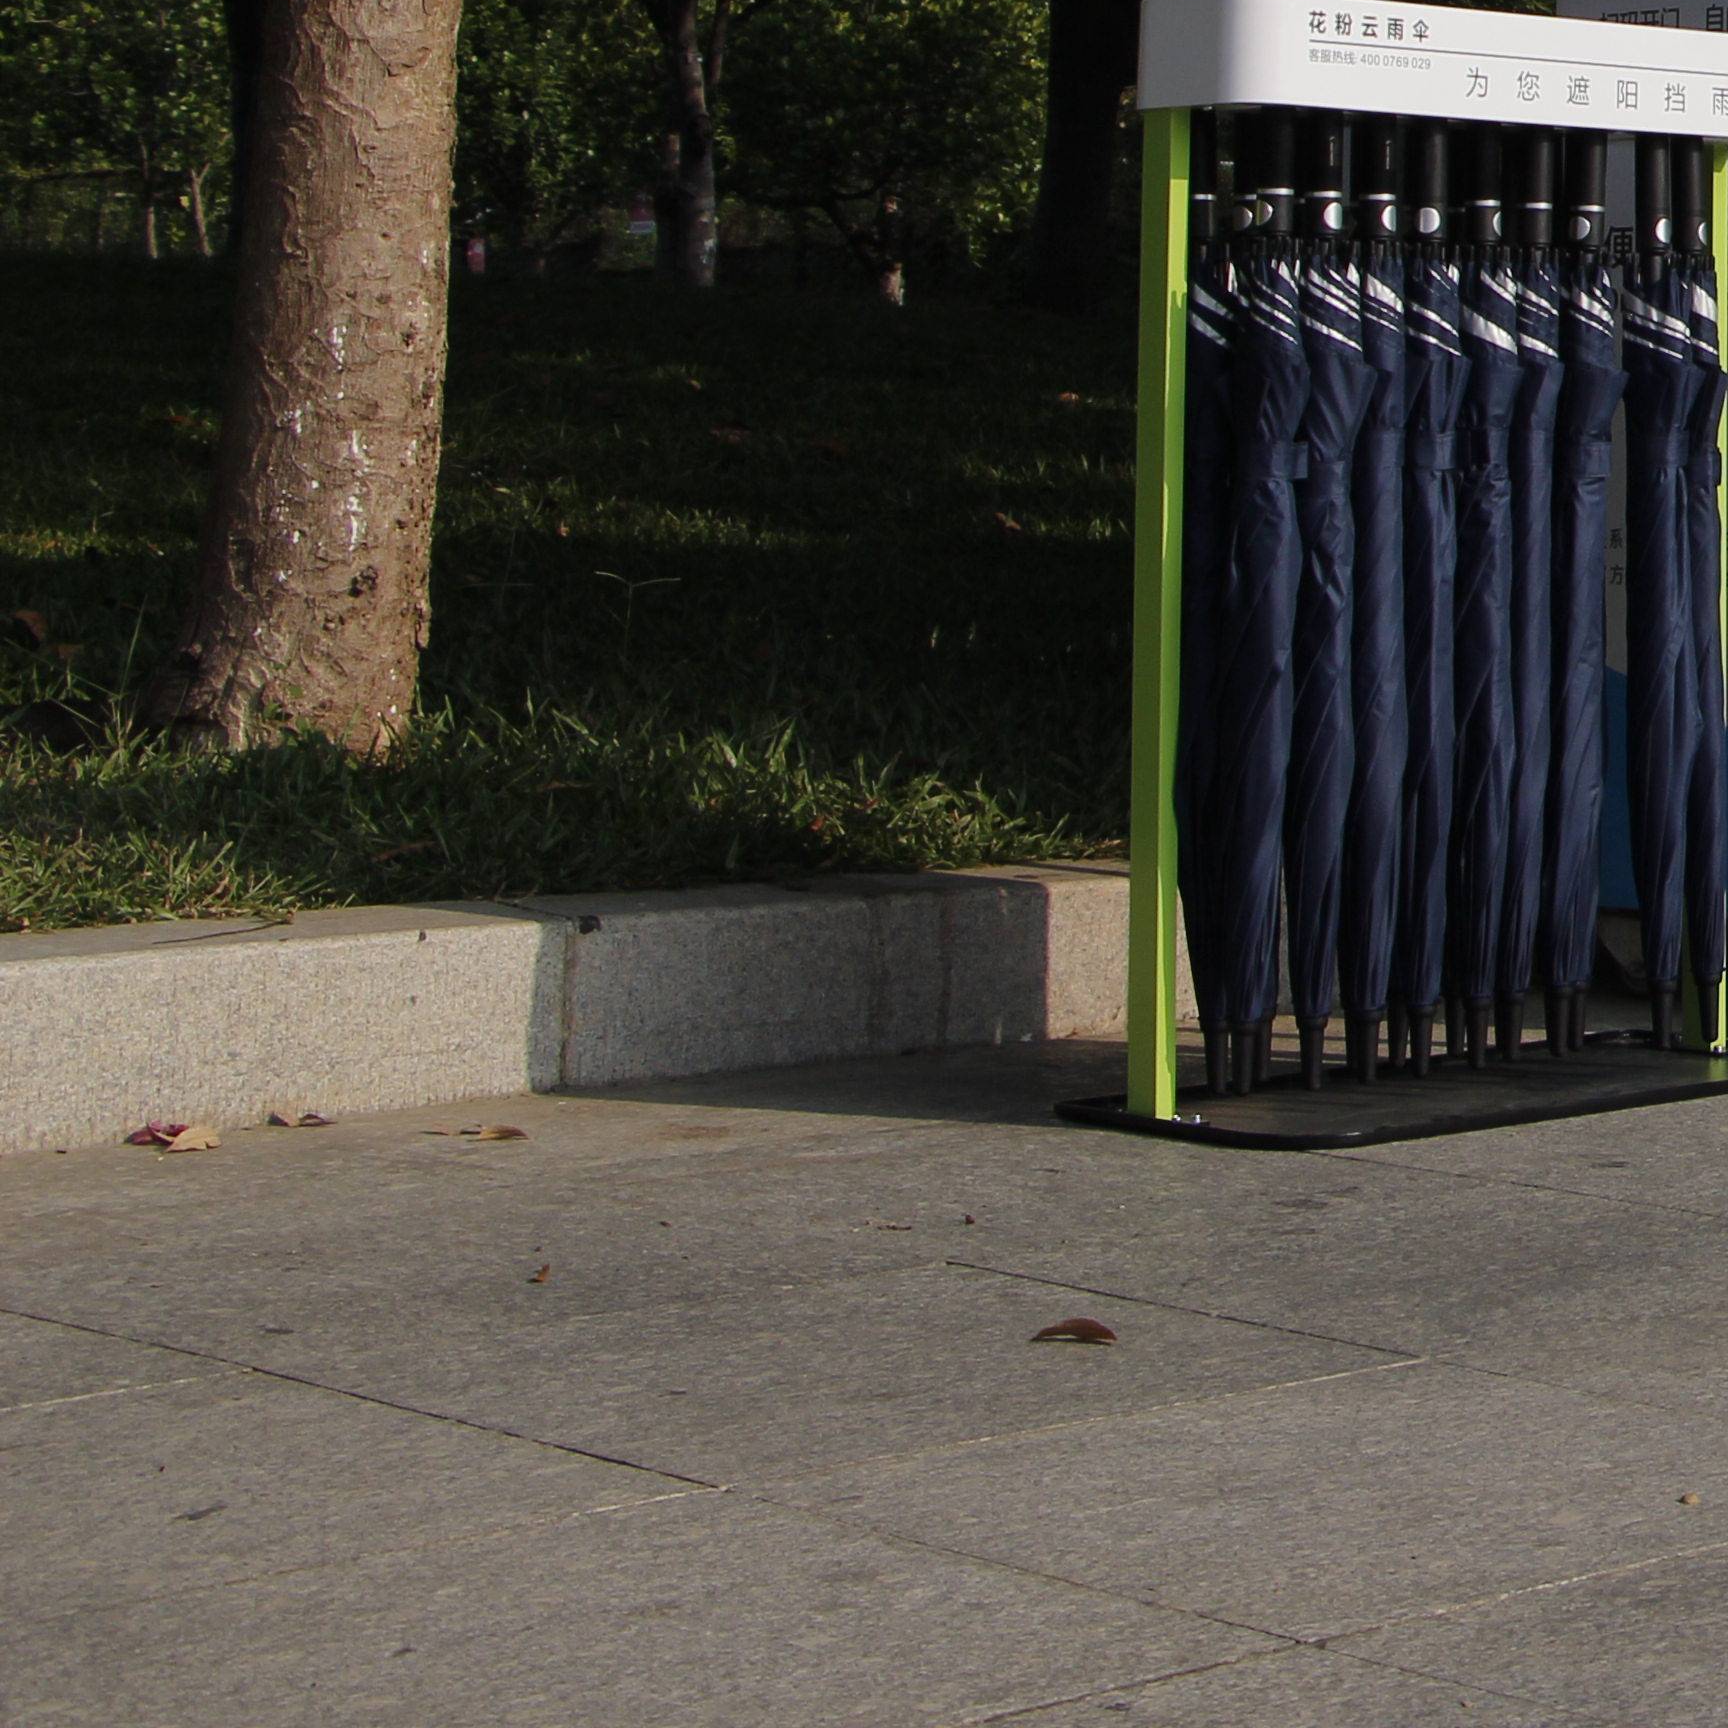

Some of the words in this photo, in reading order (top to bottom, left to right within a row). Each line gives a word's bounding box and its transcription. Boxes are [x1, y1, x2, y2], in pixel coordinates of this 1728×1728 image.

[1308, 9, 1431, 44] 花粉云雨伞
[1360, 53, 1381, 67] 400
[1383, 54, 1409, 69] 0769
[1411, 57, 1432, 70] 029
